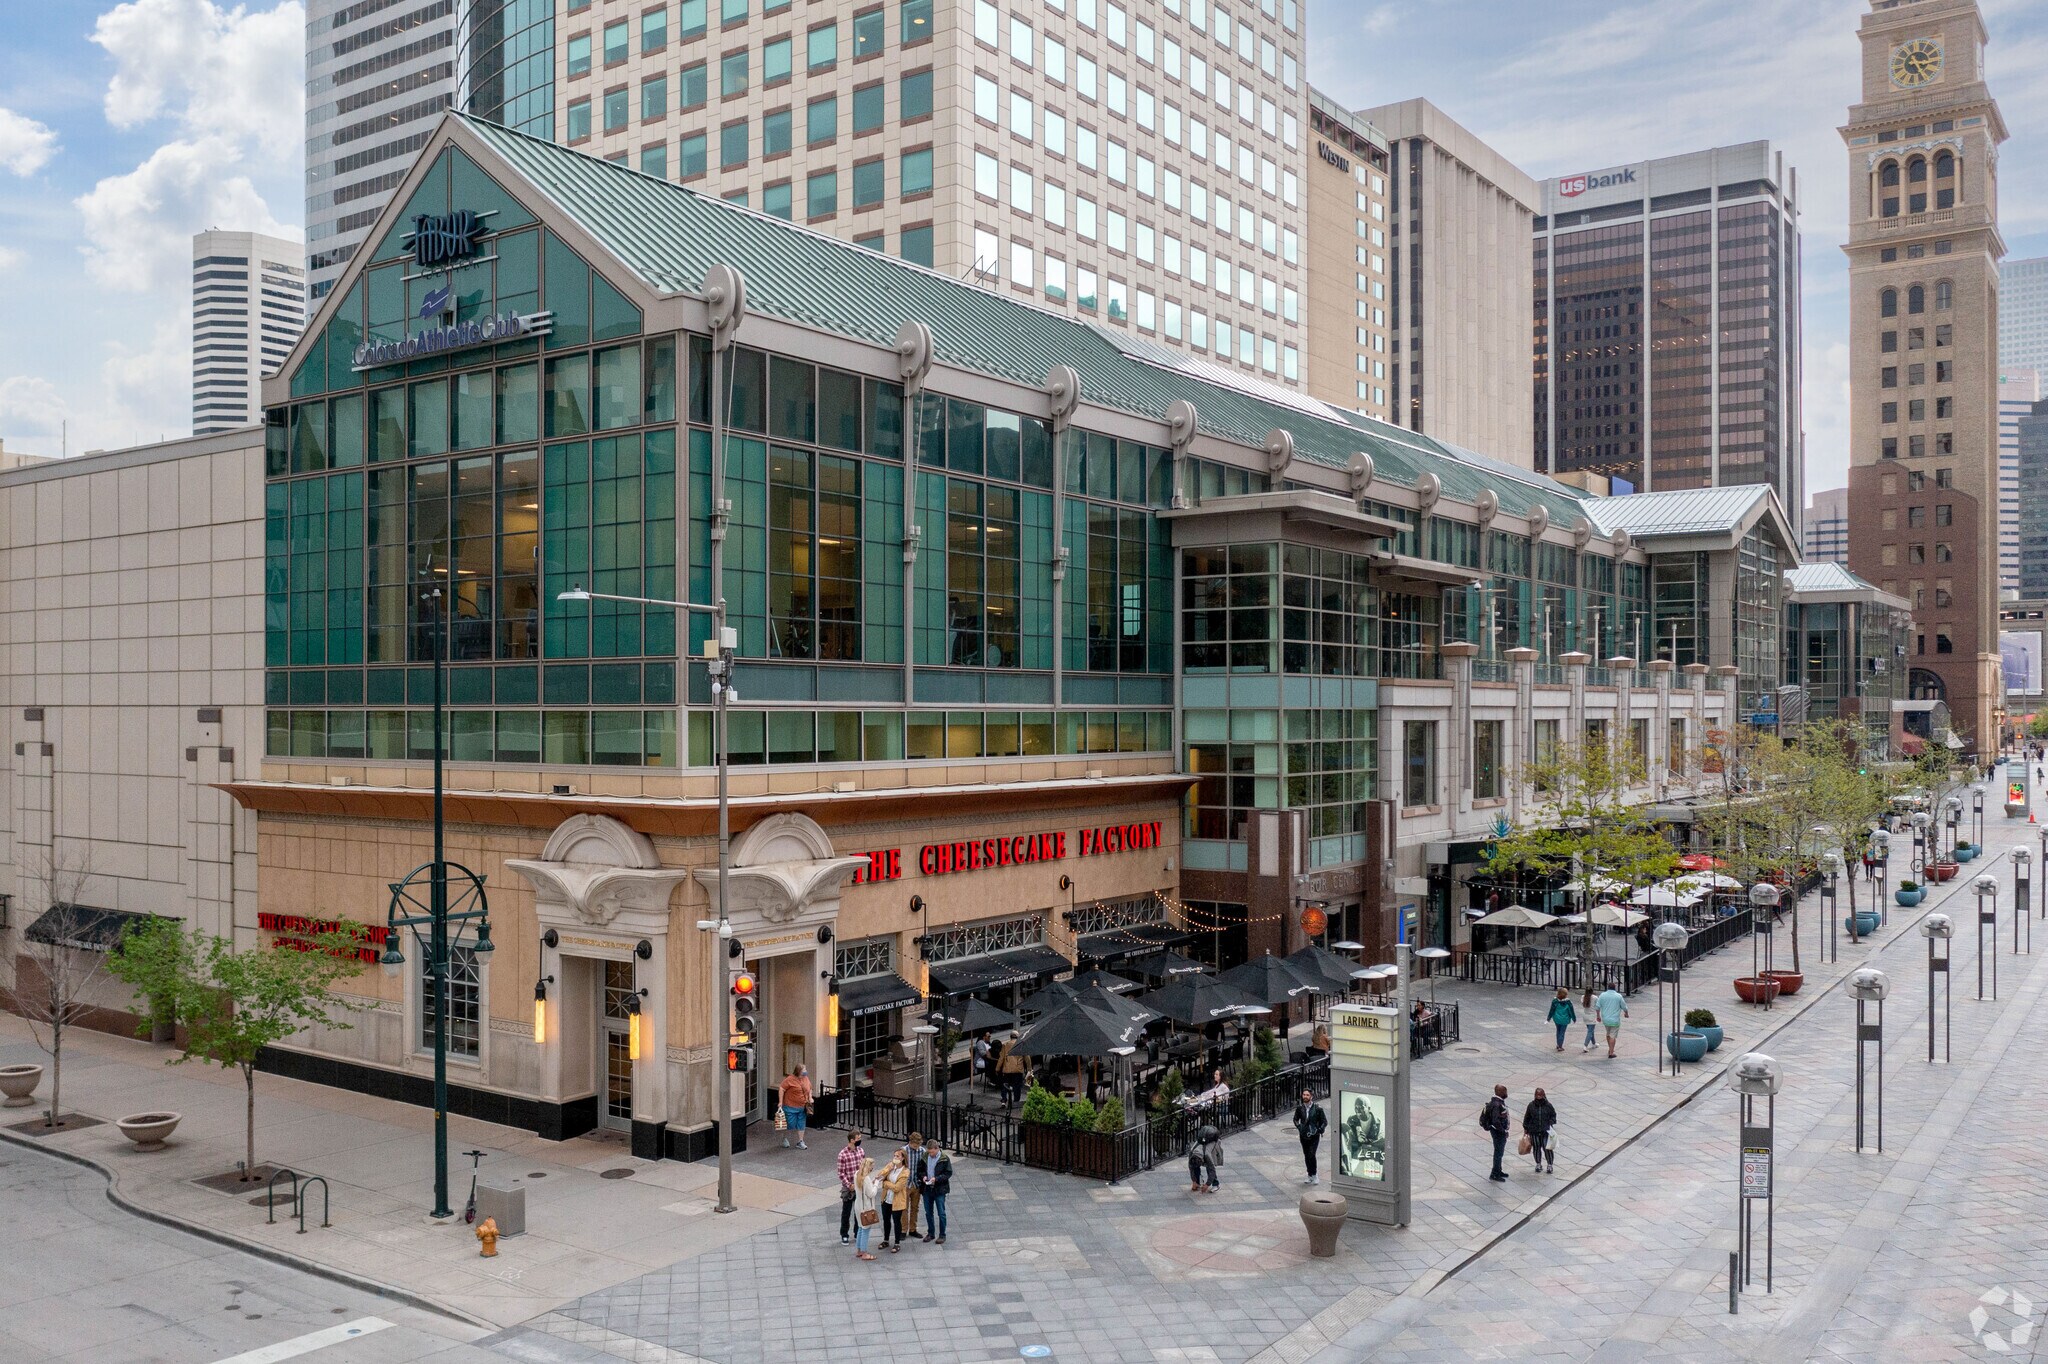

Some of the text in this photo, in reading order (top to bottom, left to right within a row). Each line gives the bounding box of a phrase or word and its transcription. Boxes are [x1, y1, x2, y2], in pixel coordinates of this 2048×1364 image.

[412, 209, 476, 266] TABOR
[850, 821, 1163, 883] THE CHEESECAKE FACTORY
[258, 912, 277, 931] THE
[852, 997, 916, 1017] THE CHEESECAKE FACTORY
[1342, 1015, 1379, 1028] LARIMER
[1358, 1149, 1386, 1161] LET'S
